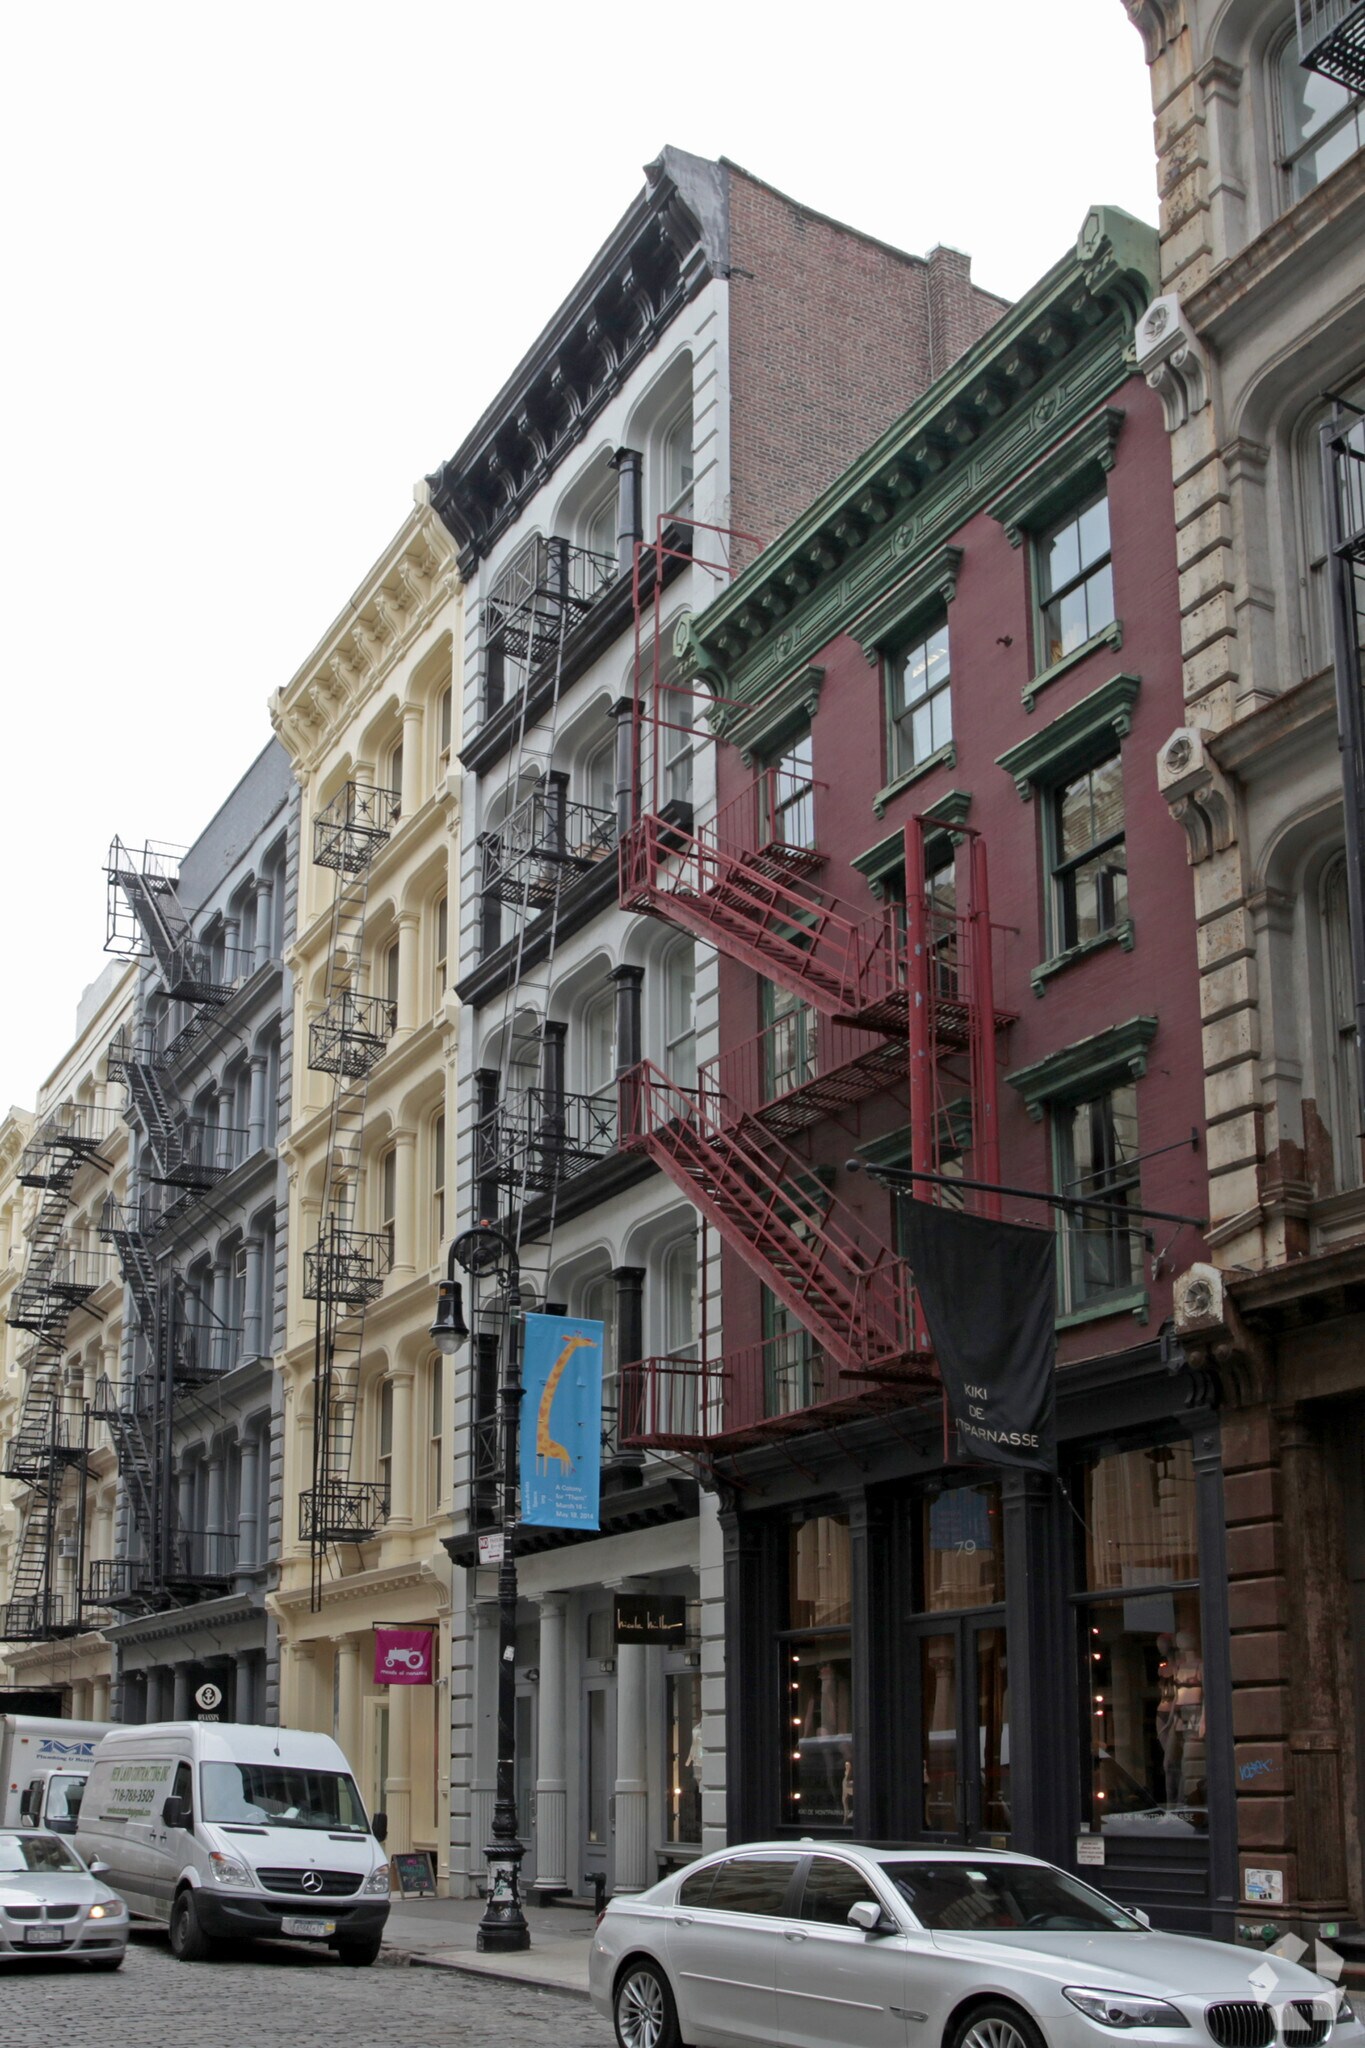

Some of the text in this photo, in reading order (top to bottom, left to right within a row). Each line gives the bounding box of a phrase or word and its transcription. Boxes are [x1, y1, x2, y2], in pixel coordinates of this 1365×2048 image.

[964, 1384, 988, 1400] KIKI
[969, 1405, 985, 1420] DE
[954, 1540, 976, 1557] 79
